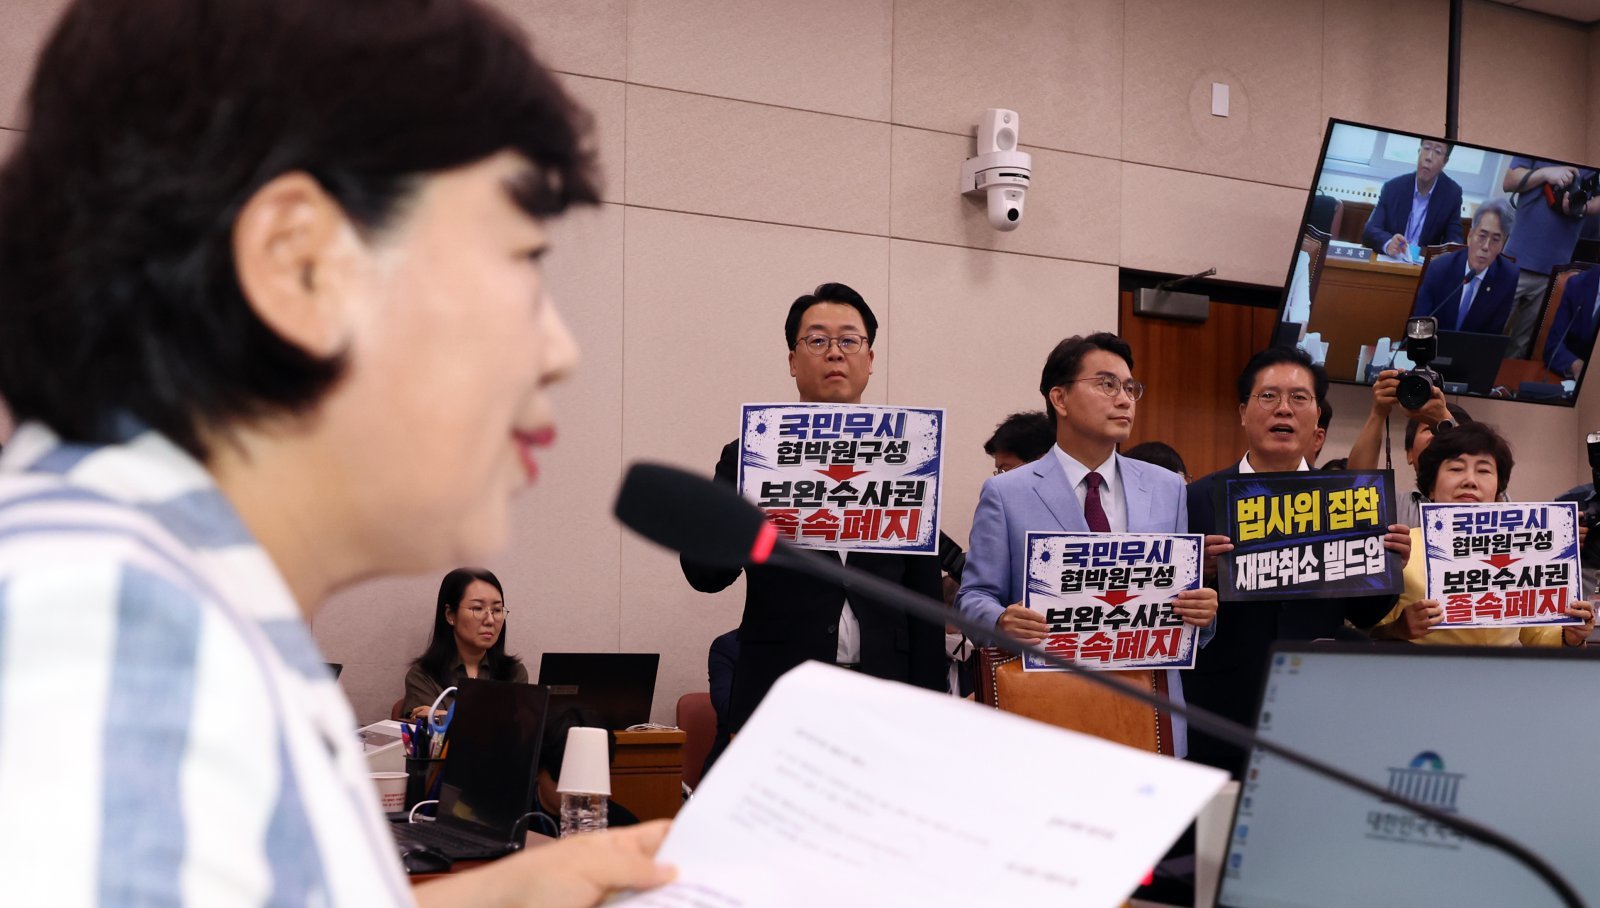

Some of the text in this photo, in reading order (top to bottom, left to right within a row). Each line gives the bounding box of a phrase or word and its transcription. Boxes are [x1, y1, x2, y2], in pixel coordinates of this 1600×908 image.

[779, 412, 907, 439] 국민무시
[777, 440, 909, 465] 협박원구성
[757, 480, 926, 507] 보완수사권
[1237, 486, 1380, 542] 법사위 집착
[1452, 507, 1548, 535] 국민무시
[1062, 539, 1173, 567] 국민무시
[1452, 531, 1553, 557] 협박원구성
[1236, 535, 1386, 591] 재판취소 빌드업
[1060, 566, 1175, 592] 협박원구성
[1442, 563, 1569, 594] 보완수사권
[1045, 603, 1184, 632] 보완수사권
[1445, 587, 1568, 623] 졸속폐지
[1045, 628, 1183, 665] 졸속폐지
